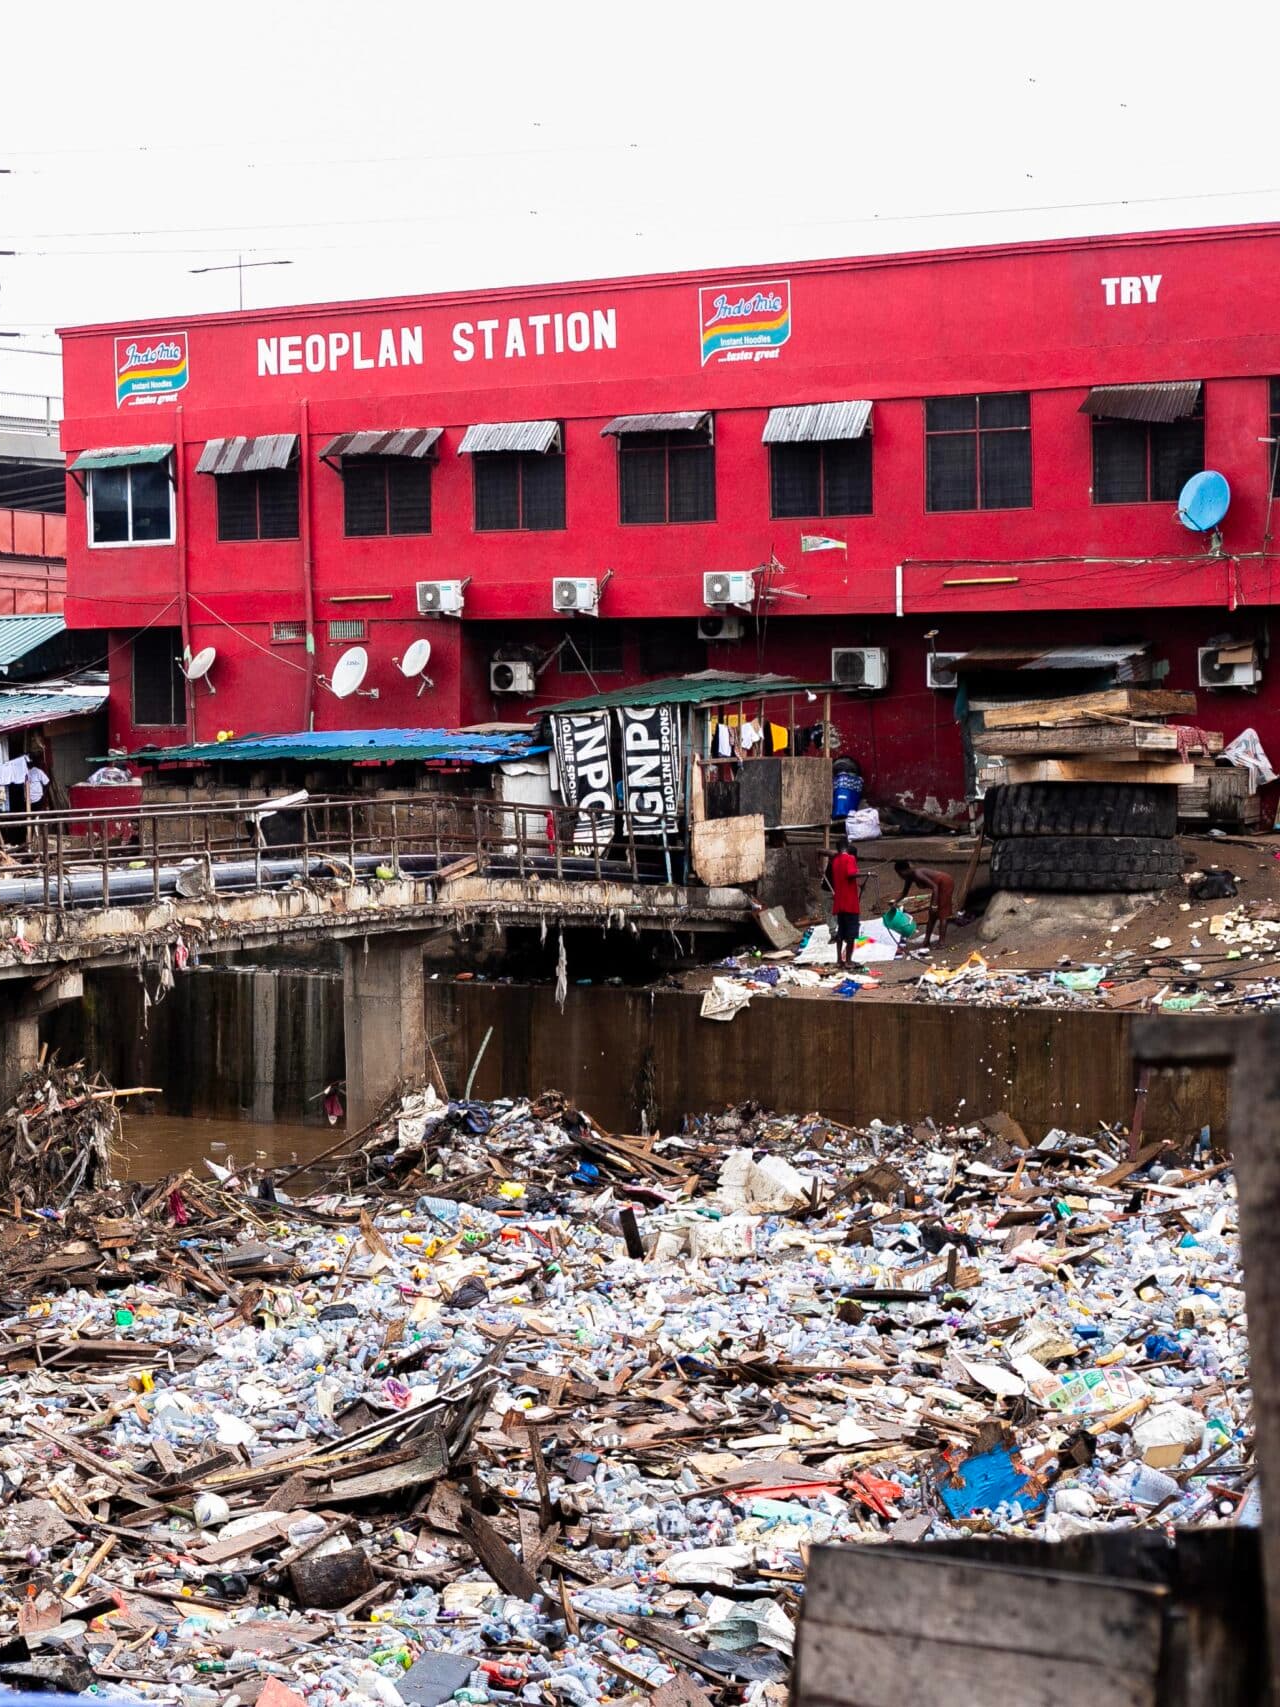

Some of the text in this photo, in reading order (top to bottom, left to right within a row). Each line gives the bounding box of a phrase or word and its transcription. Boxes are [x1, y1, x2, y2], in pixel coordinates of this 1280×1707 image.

[1101, 274, 1162, 305] TRY
[257, 309, 617, 376] NEOPLAN STATION
[720, 335, 770, 346] Instant Noodles
[754, 348, 780, 362] great
